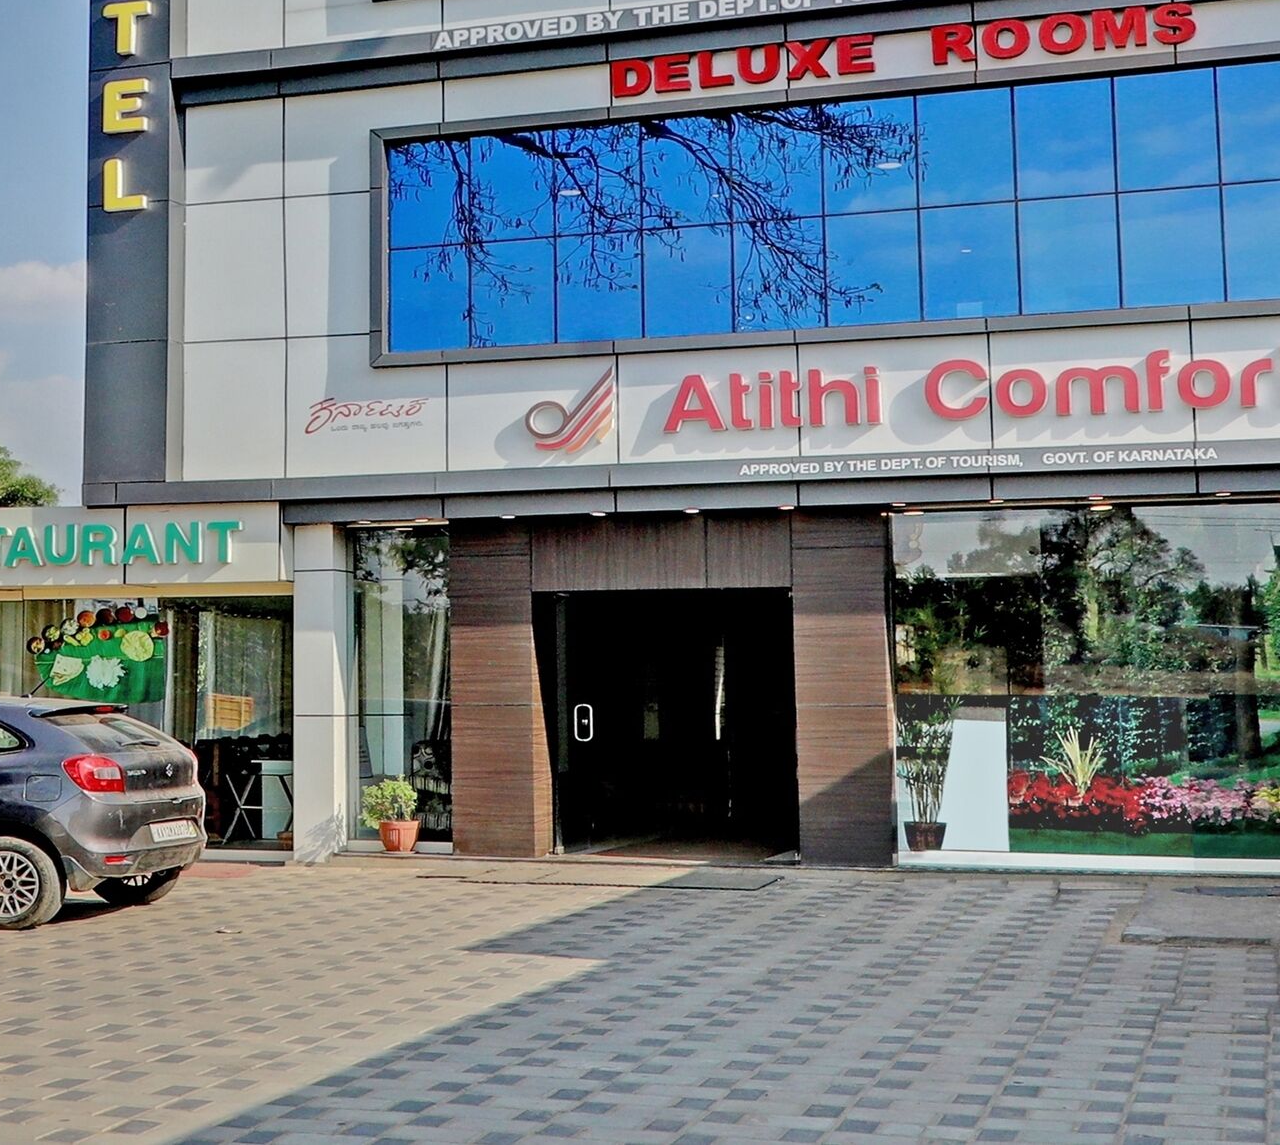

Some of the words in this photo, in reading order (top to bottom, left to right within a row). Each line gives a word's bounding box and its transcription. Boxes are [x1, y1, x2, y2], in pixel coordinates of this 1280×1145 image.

[433, 15, 577, 50] APPROVED
[586, 10, 624, 33] BY
[633, 2, 690, 27] THE
[610, 33, 876, 99] DELUXE
[930, 2, 1197, 66] ROOMS
[663, 365, 883, 434] Atithi
[739, 461, 820, 476] APPROVED
[823, 460, 844, 473] BY
[847, 458, 877, 472] THE
[880, 457, 923, 471] DEPT.
[926, 456, 946, 469] OF
[1042, 451, 1089, 465] GOVT.
[1093, 450, 1115, 463] OF
[1117, 447, 1218, 463] KARNATAKA
